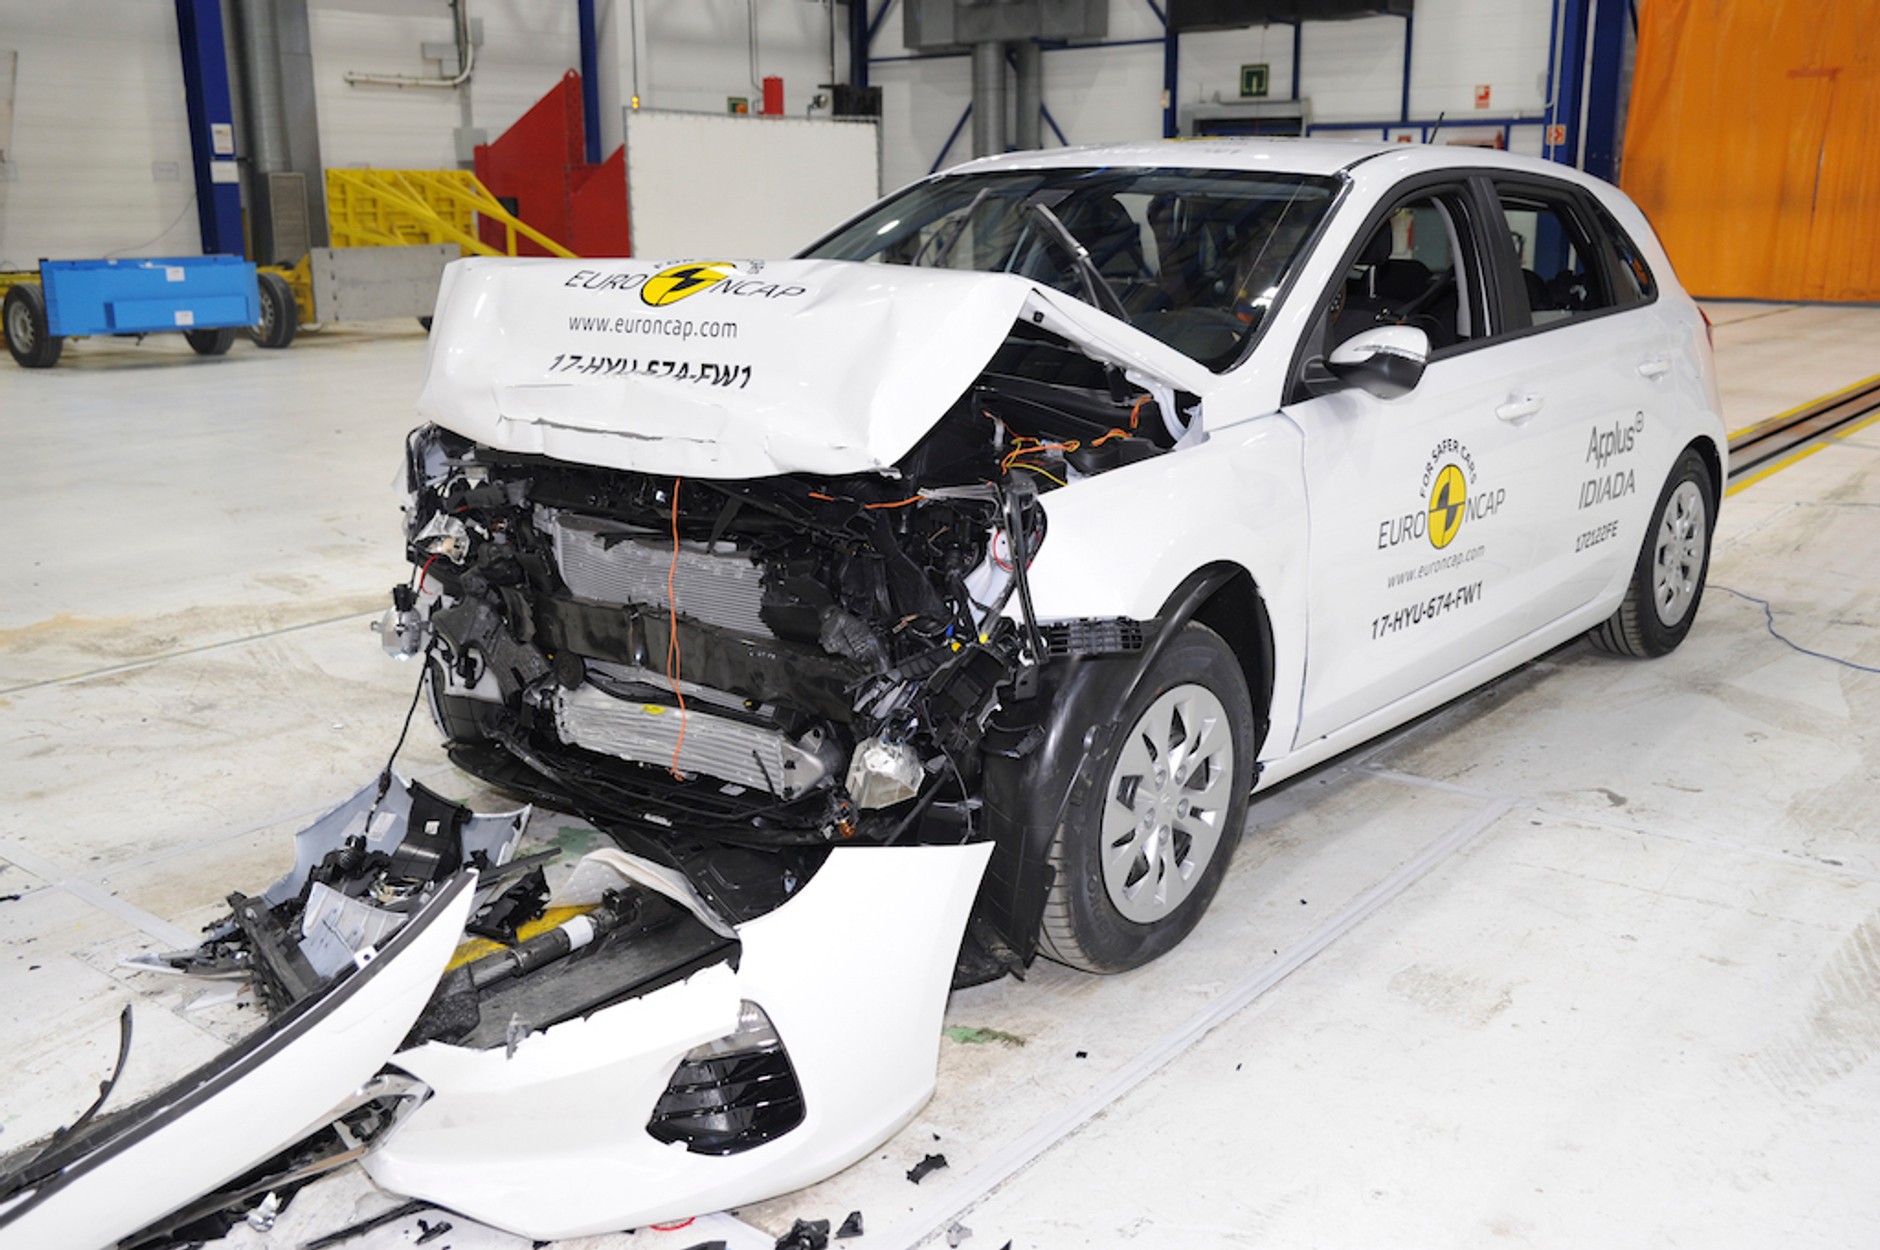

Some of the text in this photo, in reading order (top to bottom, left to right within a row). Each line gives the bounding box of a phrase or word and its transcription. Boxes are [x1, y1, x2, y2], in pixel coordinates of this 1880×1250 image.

[565, 269, 807, 299] EURO NCAP
[568, 315, 738, 341] www.euroncap.com
[548, 353, 752, 389] 17-HYU674-FW1
[1585, 420, 1635, 470] Applus
[1419, 438, 1478, 499] FOR SAFER CARS
[1578, 468, 1636, 510] IDIADA
[1377, 488, 1506, 550] EURO NCAP
[1386, 545, 1486, 589] www.euroncap.com
[1370, 580, 1484, 641] 17-HYU-674-FW1
